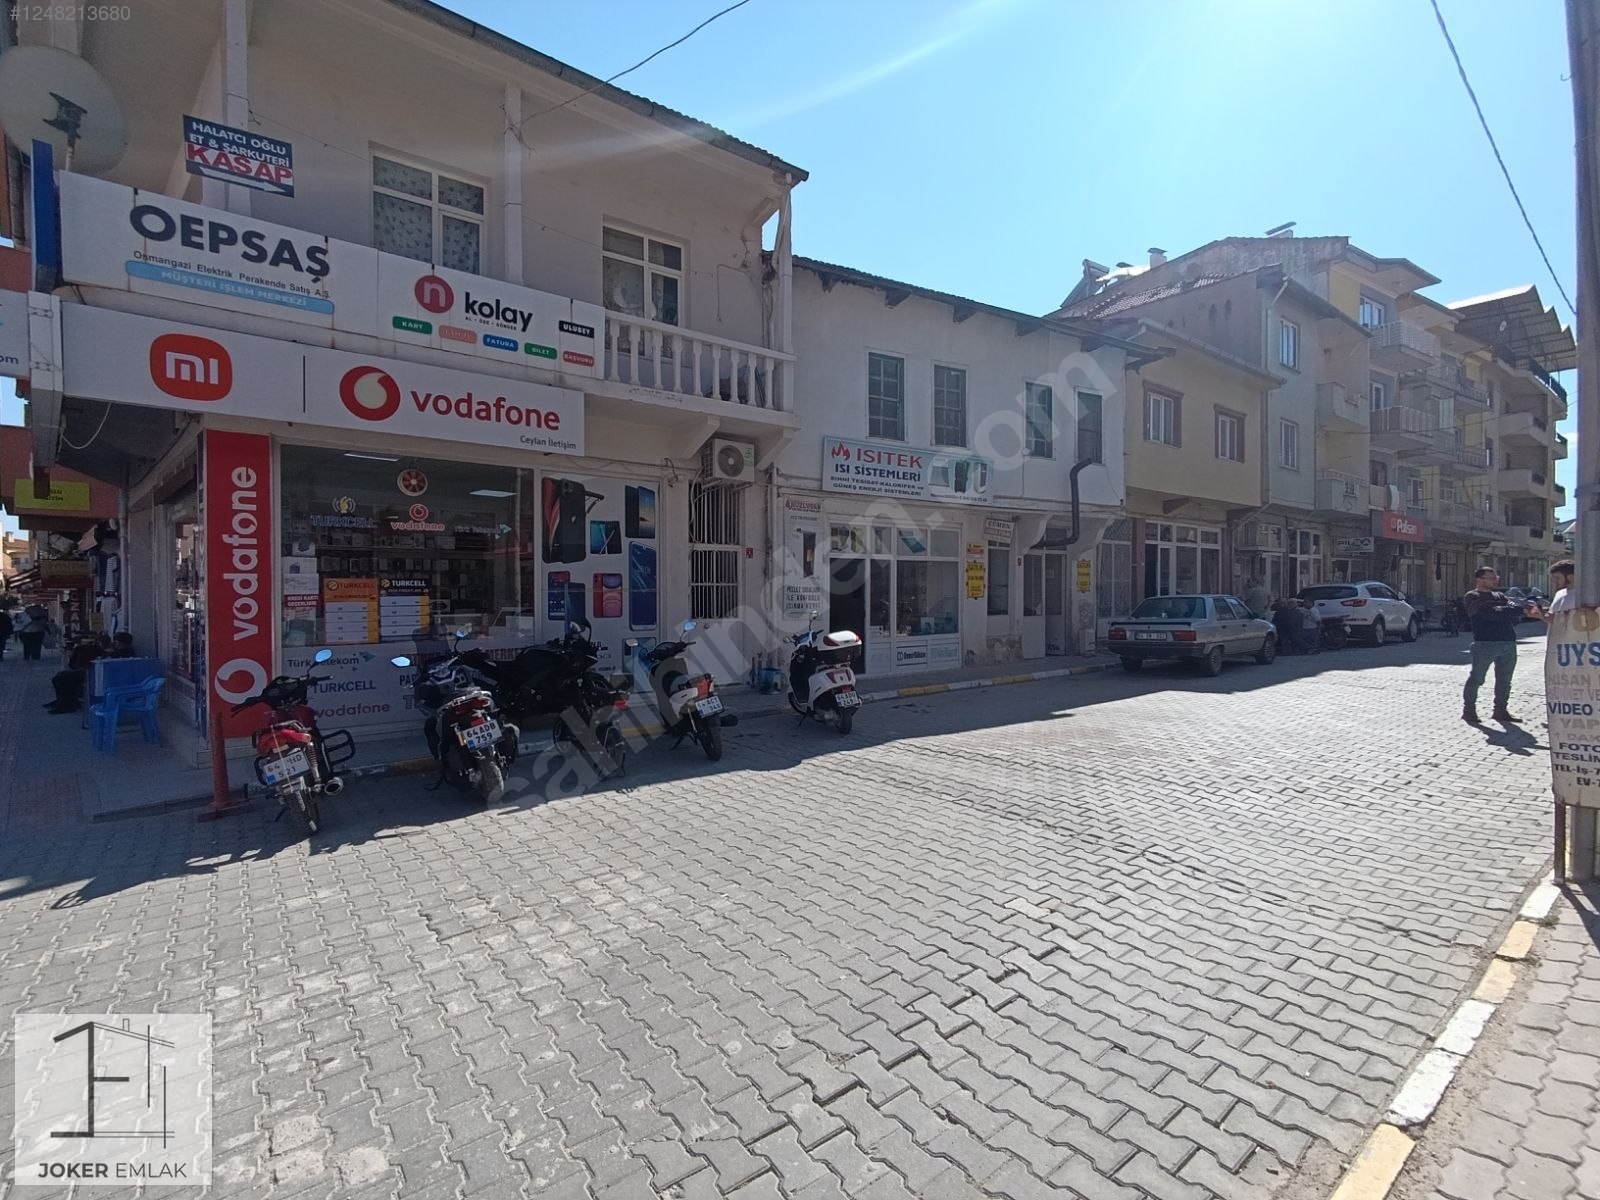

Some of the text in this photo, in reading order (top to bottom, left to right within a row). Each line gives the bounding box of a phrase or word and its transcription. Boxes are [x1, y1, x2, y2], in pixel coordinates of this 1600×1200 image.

[189, 133, 204, 145] ET
[208, 138, 219, 149] &
[250, 138, 286, 155] OĞLU
[187, 143, 292, 184] KASAP
[129, 204, 330, 284] OEPSAŞ
[133, 250, 191, 271] Osmangazi
[197, 263, 233, 278] Elektrik
[239, 272, 286, 290] Perakende
[289, 282, 310, 296] Satış
[160, 271, 307, 306] MÜŞTERİ İŞLEM MERKEZİ
[464, 291, 533, 333] kolay
[401, 320, 424, 330] KART
[486, 337, 516, 348] FATURA
[409, 390, 560, 432] vodafone
[519, 435, 577, 450] Ceylan İletişim
[835, 463, 922, 483] ISI SİSTEMLERİ
[390, 521, 446, 532] vodafone
[222, 465, 260, 641] vodafone
[391, 579, 427, 588] TURKCELL
[287, 658, 311, 669] Türk
[317, 703, 391, 719] vodafone
[1547, 700, 1593, 716] VİDEO
[467, 730, 478, 738] 64
[475, 732, 493, 744] 759
